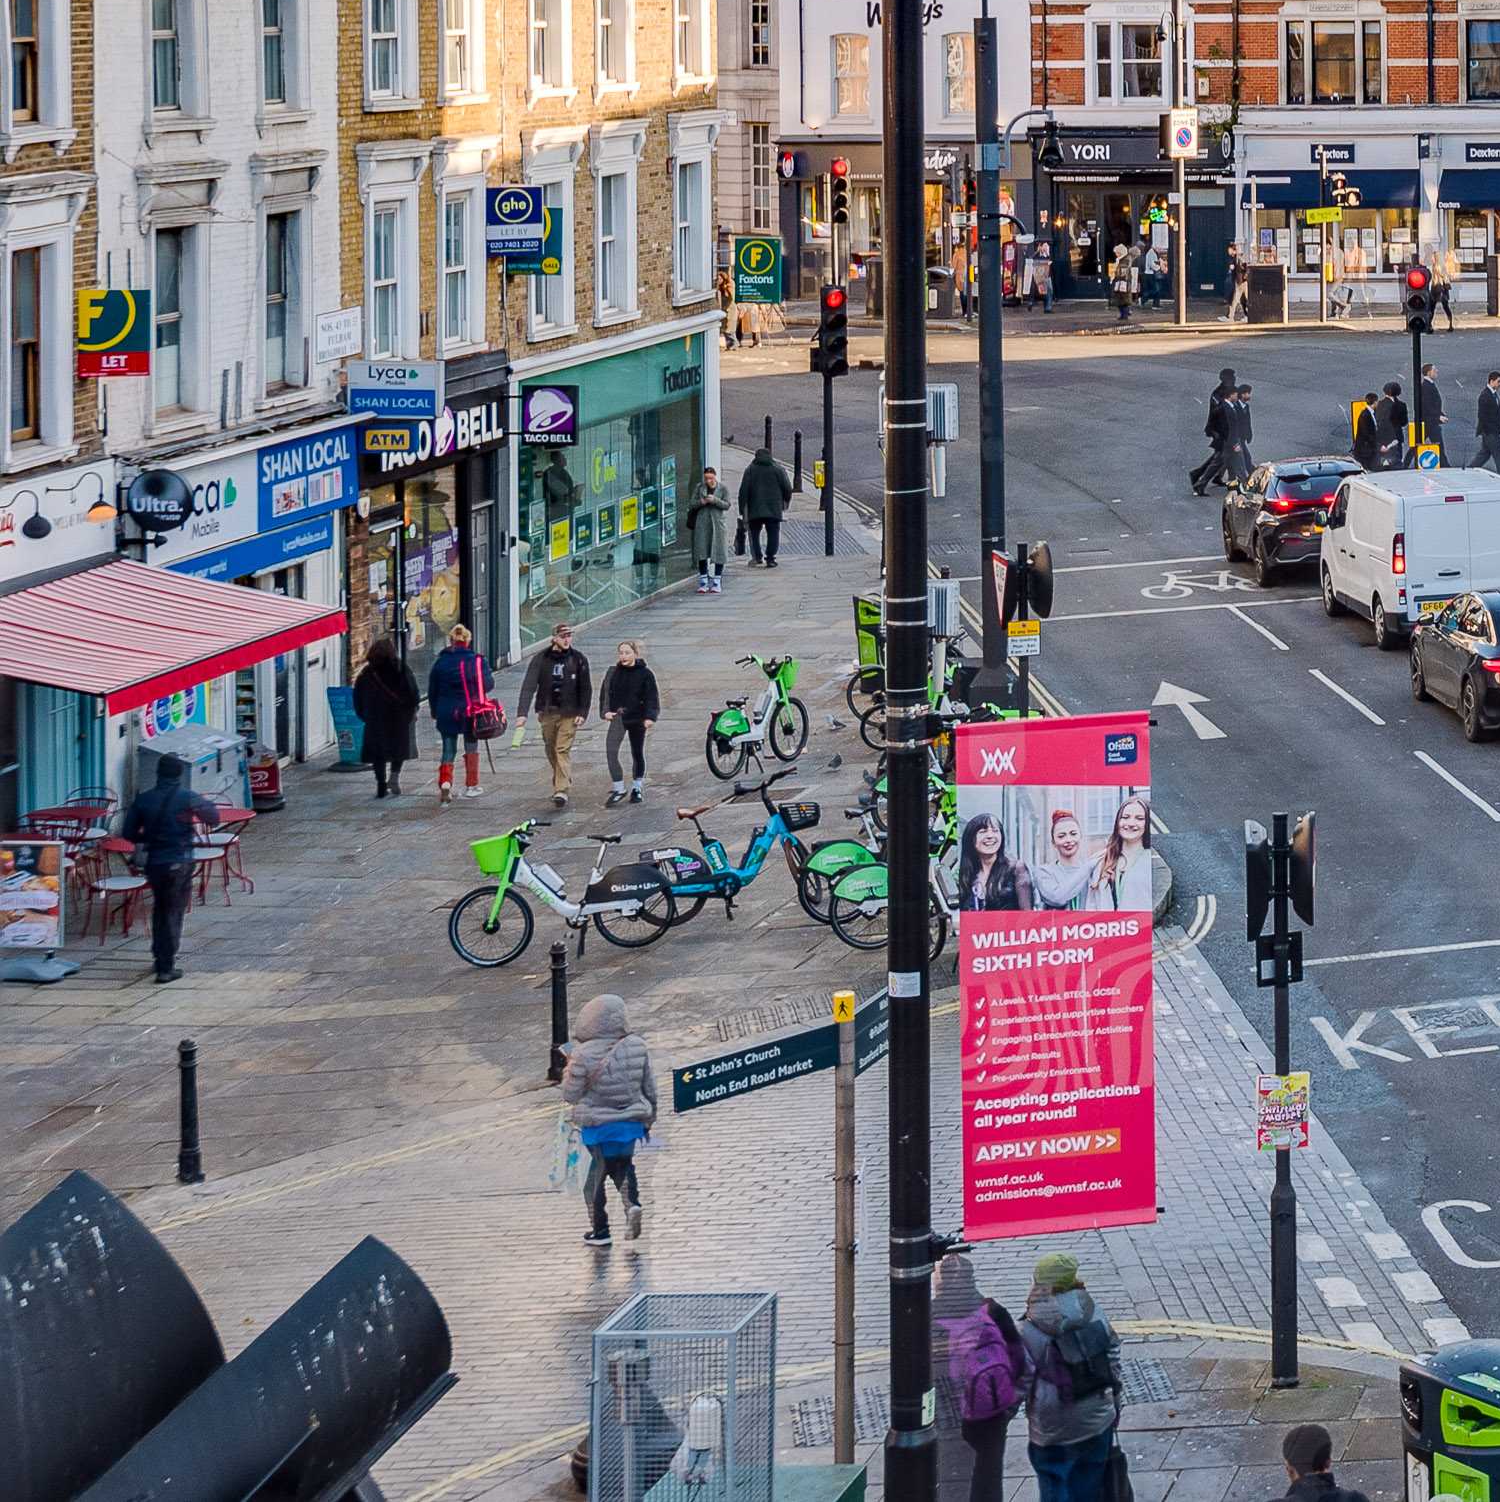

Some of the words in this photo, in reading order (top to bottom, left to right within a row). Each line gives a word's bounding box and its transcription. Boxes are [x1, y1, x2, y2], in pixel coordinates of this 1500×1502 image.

[866, 0, 944, 28] Wy's
[1071, 144, 1111, 160] YORI
[751, 247, 763, 268] F
[739, 273, 774, 284] Foxtons
[101, 355, 128, 368] LET
[368, 365, 407, 384] Lyca
[663, 364, 702, 394] Foxtons
[355, 398, 389, 409] SHAN
[392, 398, 431, 409] LOCAL
[457, 402, 504, 449] BELL
[370, 434, 405, 446] ATM
[524, 434, 549, 443] TACO
[550, 434, 573, 443] BELL
[262, 450, 303, 484] SHAN
[306, 435, 350, 471] LOCAL
[191, 519, 220, 540] Mobile
[1108, 740, 1135, 752] Ofsted
[972, 927, 1058, 950] WILLIAM
[1062, 919, 1140, 942] MORRIS
[972, 952, 1032, 974] SIXTH
[1037, 947, 1094, 968] FORM
[991, 1012, 1042, 1027] Experienced
[1044, 1011, 1060, 1020] and
[1062, 1007, 1105, 1022] supportive
[1107, 1004, 1144, 1015] teachers
[992, 1034, 1033, 1047] Engaging
[1033, 1028, 1094, 1041] Extracurricular
[1095, 1024, 1133, 1035] Activities
[695, 1067, 707, 1080] St
[709, 1057, 743, 1076] John's
[744, 1046, 781, 1066] Church
[992, 1053, 1030, 1065] Excellent
[1031, 1050, 1062, 1061] Results
[696, 1085, 727, 1103] North
[729, 1076, 749, 1093] End
[750, 1068, 776, 1087] Road
[778, 1058, 813, 1077] Market
[992, 1069, 1048, 1083] Pre-university
[1049, 1065, 1101, 1078] Environment
[974, 1091, 1049, 1111] Accepting
[1051, 1084, 1141, 1104] applications
[974, 1115, 992, 1128] all
[994, 1112, 1027, 1128] year
[1030, 1106, 1077, 1122] round!
[975, 1141, 1037, 1162] APPLY
[1041, 1135, 1091, 1156] NOW
[975, 1172, 1044, 1188] wmsf.ac.uk
[975, 1177, 1122, 1203] admissions@wmsf.ac.uk
